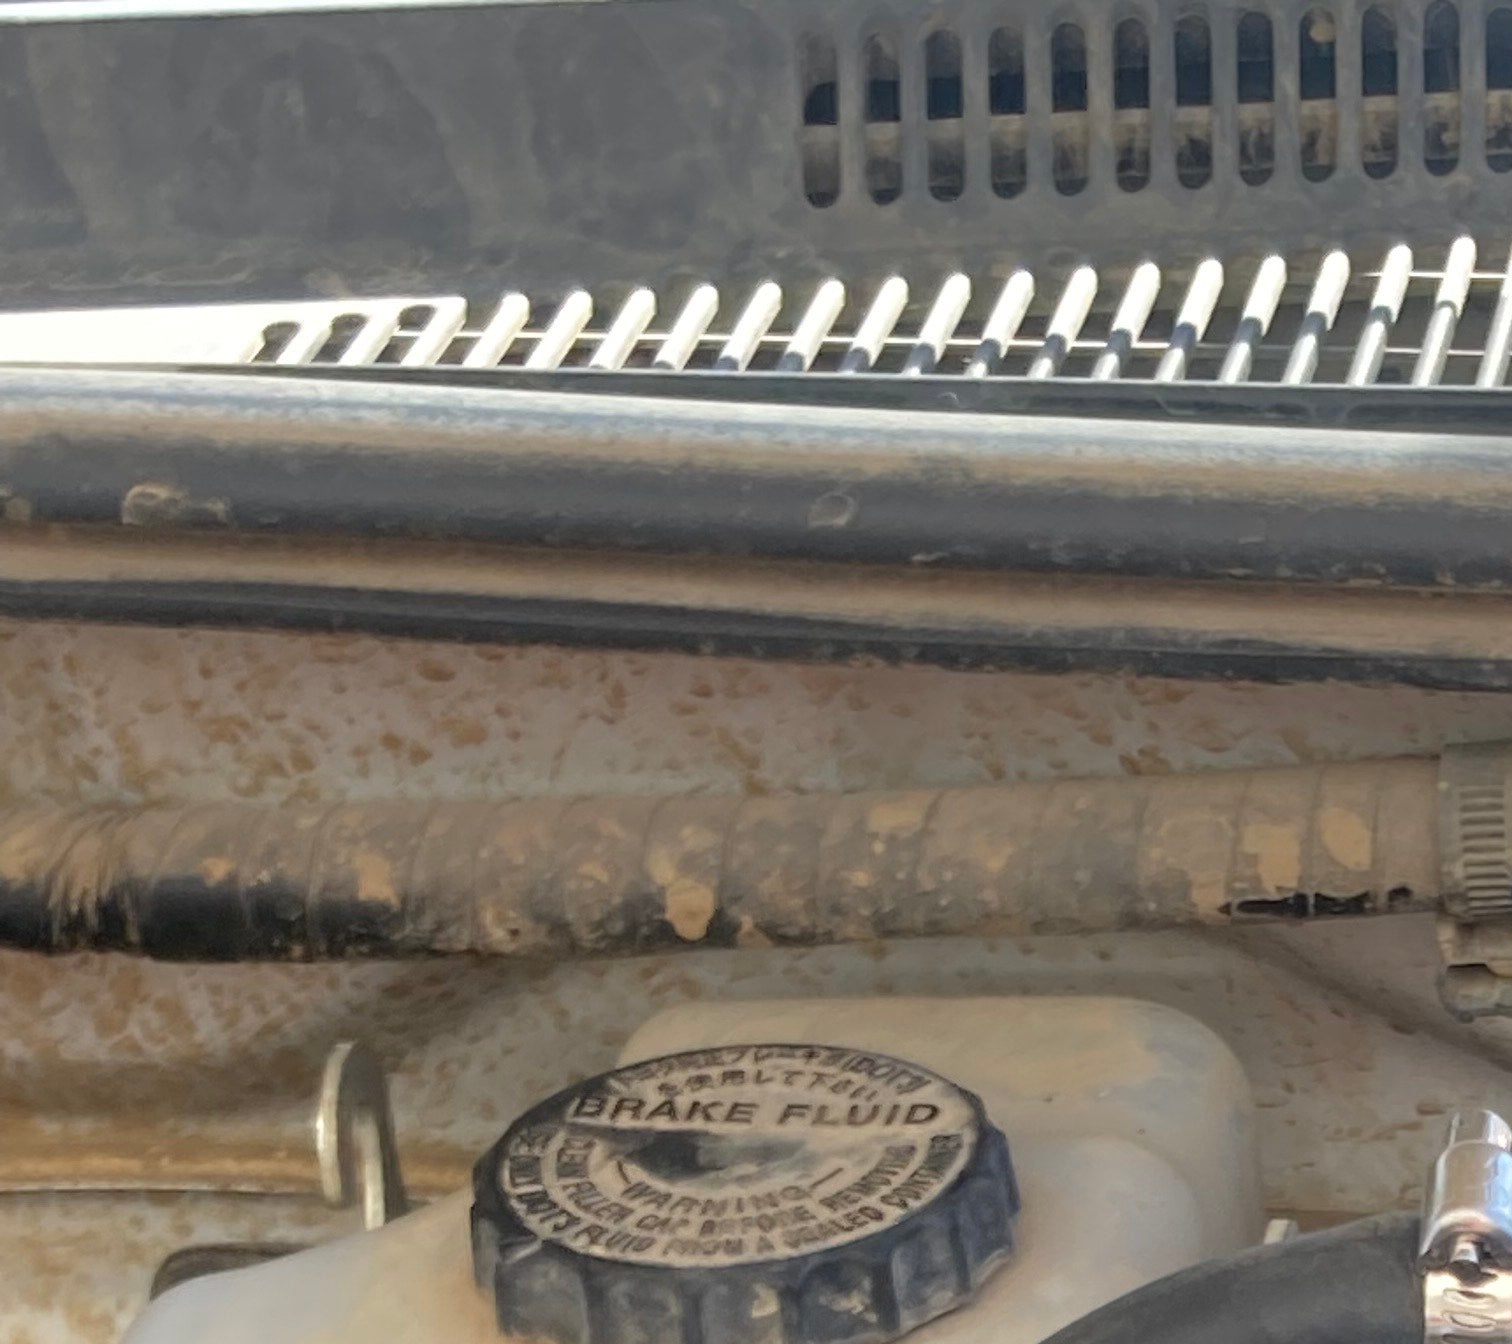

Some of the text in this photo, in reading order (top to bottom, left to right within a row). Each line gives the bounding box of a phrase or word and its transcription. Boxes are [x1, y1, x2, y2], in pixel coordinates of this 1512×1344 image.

[573, 1098, 940, 1127] BRAKE FLUID
[621, 1181, 806, 1217] WARNING
